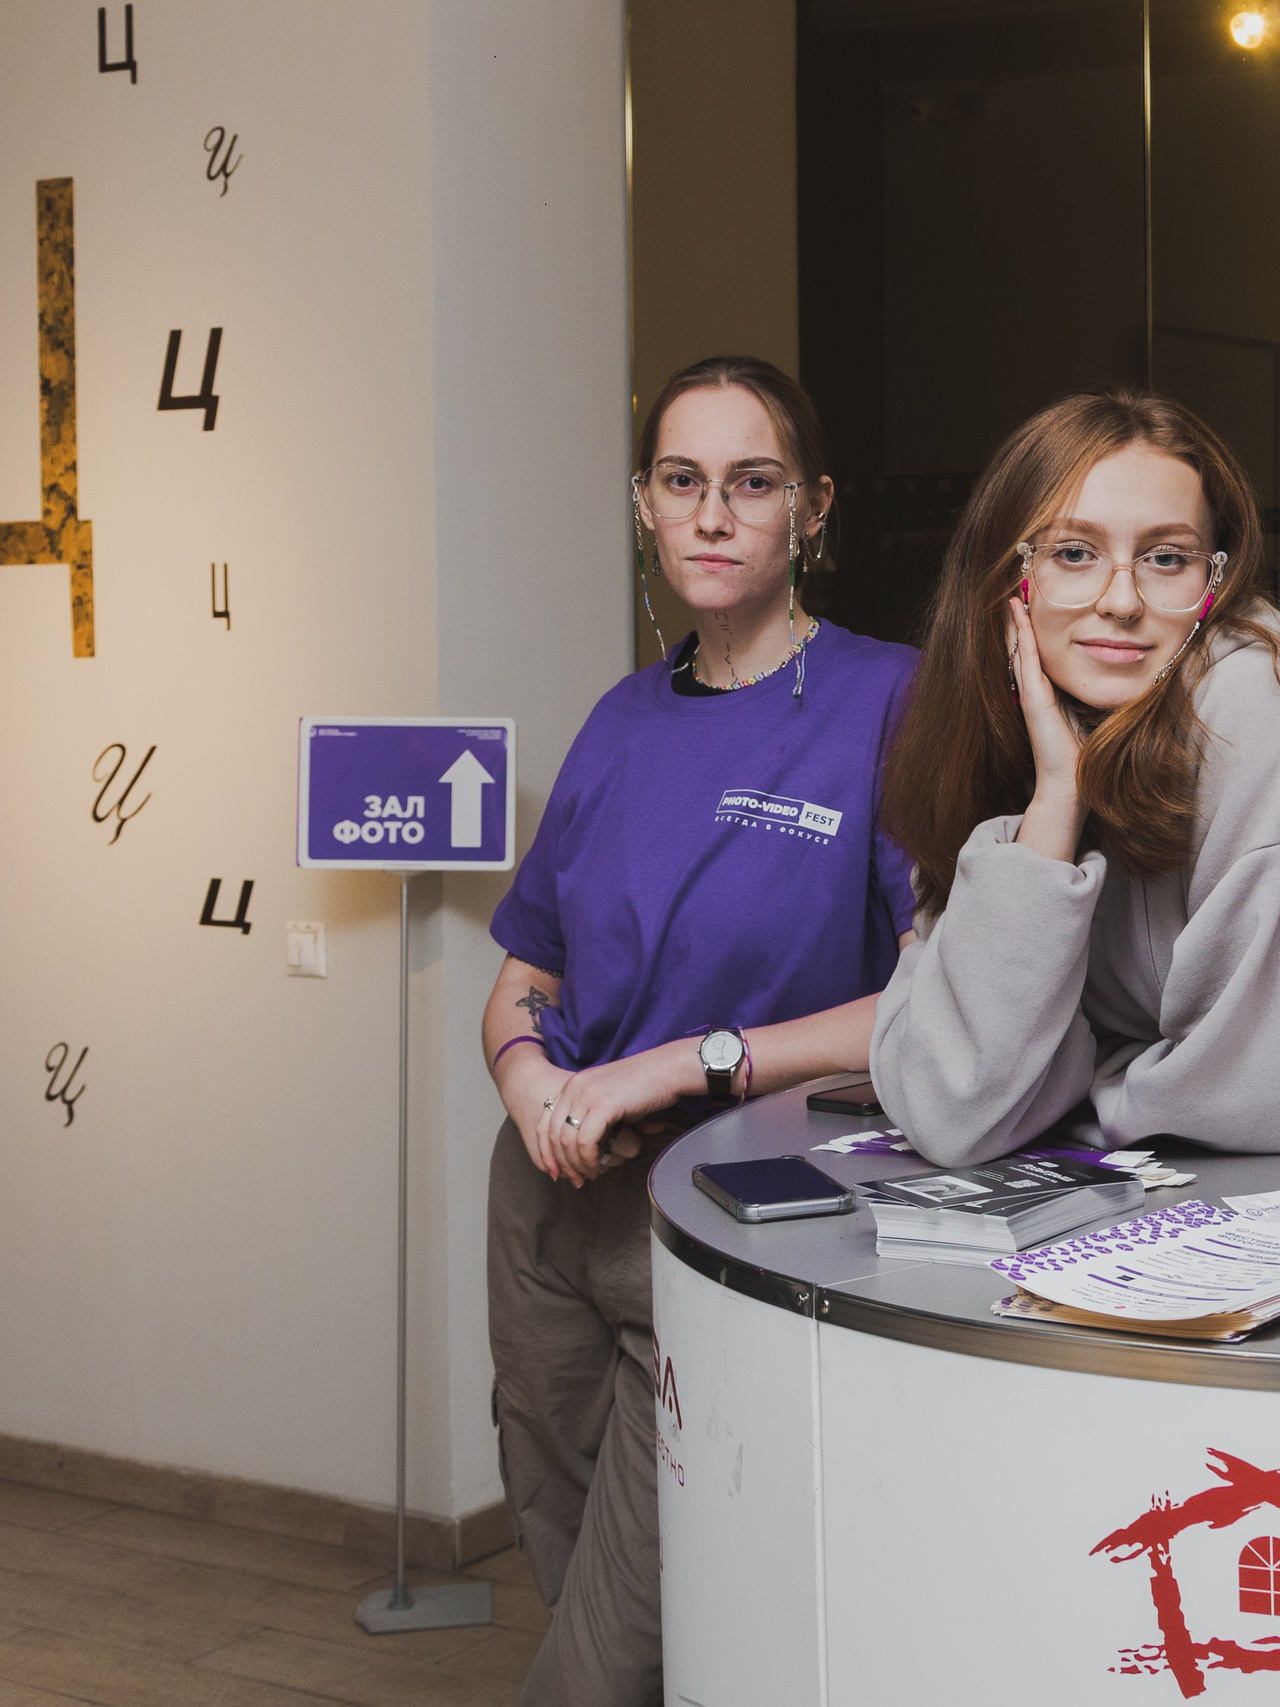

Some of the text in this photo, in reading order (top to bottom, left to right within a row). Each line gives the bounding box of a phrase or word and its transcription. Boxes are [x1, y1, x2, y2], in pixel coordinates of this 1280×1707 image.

[363, 795, 425, 819] ЗАЛ
[721, 796, 835, 827] PHOTO-VIDEO FEST
[332, 819, 425, 845] ФОТО
[714, 815, 830, 846] ВСЕГДА В ФОКУСЕ
